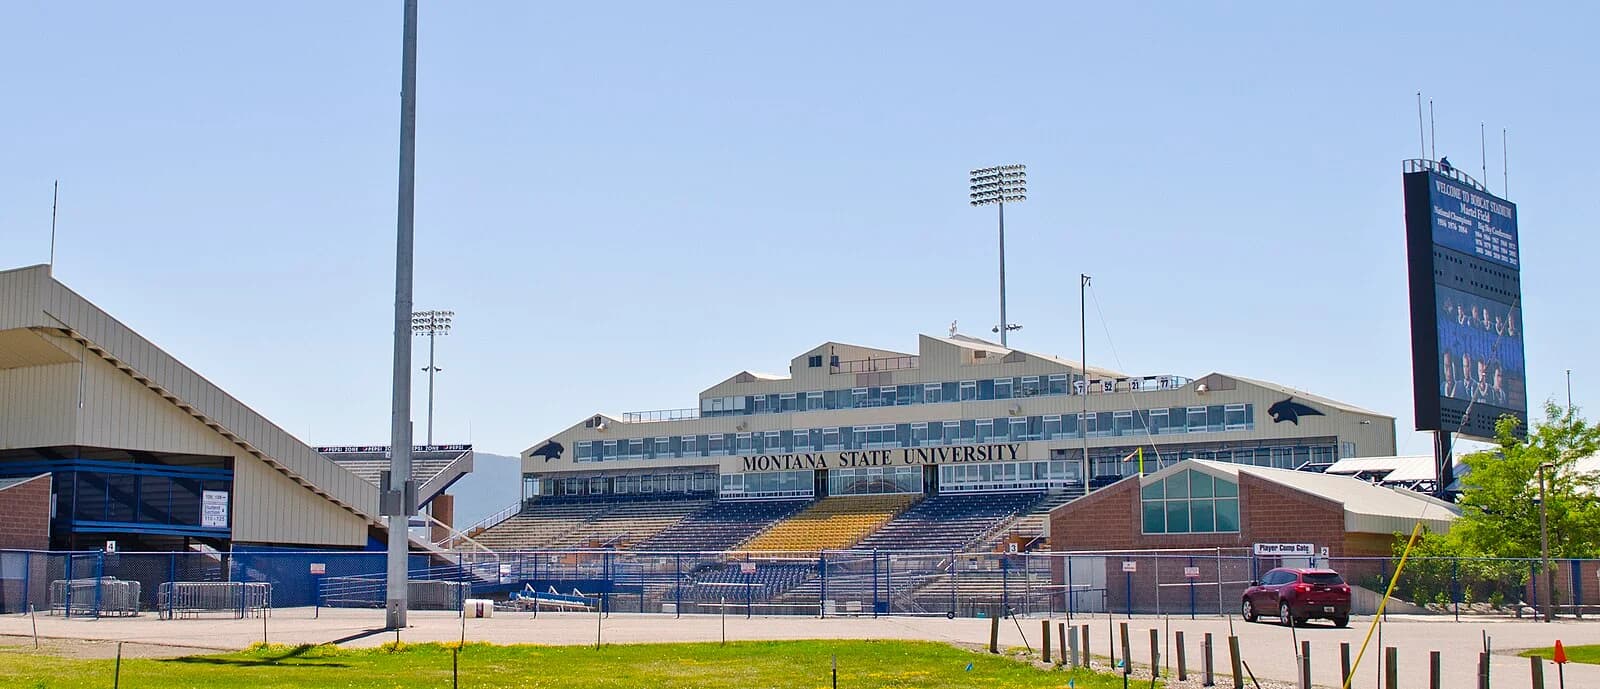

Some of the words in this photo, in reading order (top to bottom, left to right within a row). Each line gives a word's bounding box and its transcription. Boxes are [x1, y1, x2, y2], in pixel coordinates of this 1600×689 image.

[1435, 180, 1461, 200] WELCOME
[1462, 190, 1470, 204] TO
[1470, 193, 1490, 210] BOBCAT
[1490, 201, 1512, 219] STADIUM
[1477, 209, 1490, 223] Field
[1104, 381, 1112, 391] 52
[1131, 381, 1139, 390] 21
[1160, 379, 1168, 389] 77
[743, 454, 827, 472] MONTANA
[839, 450, 892, 467] STATE
[904, 444, 1020, 464] UNIVERSITY
[1296, 544, 1309, 552] Gate
